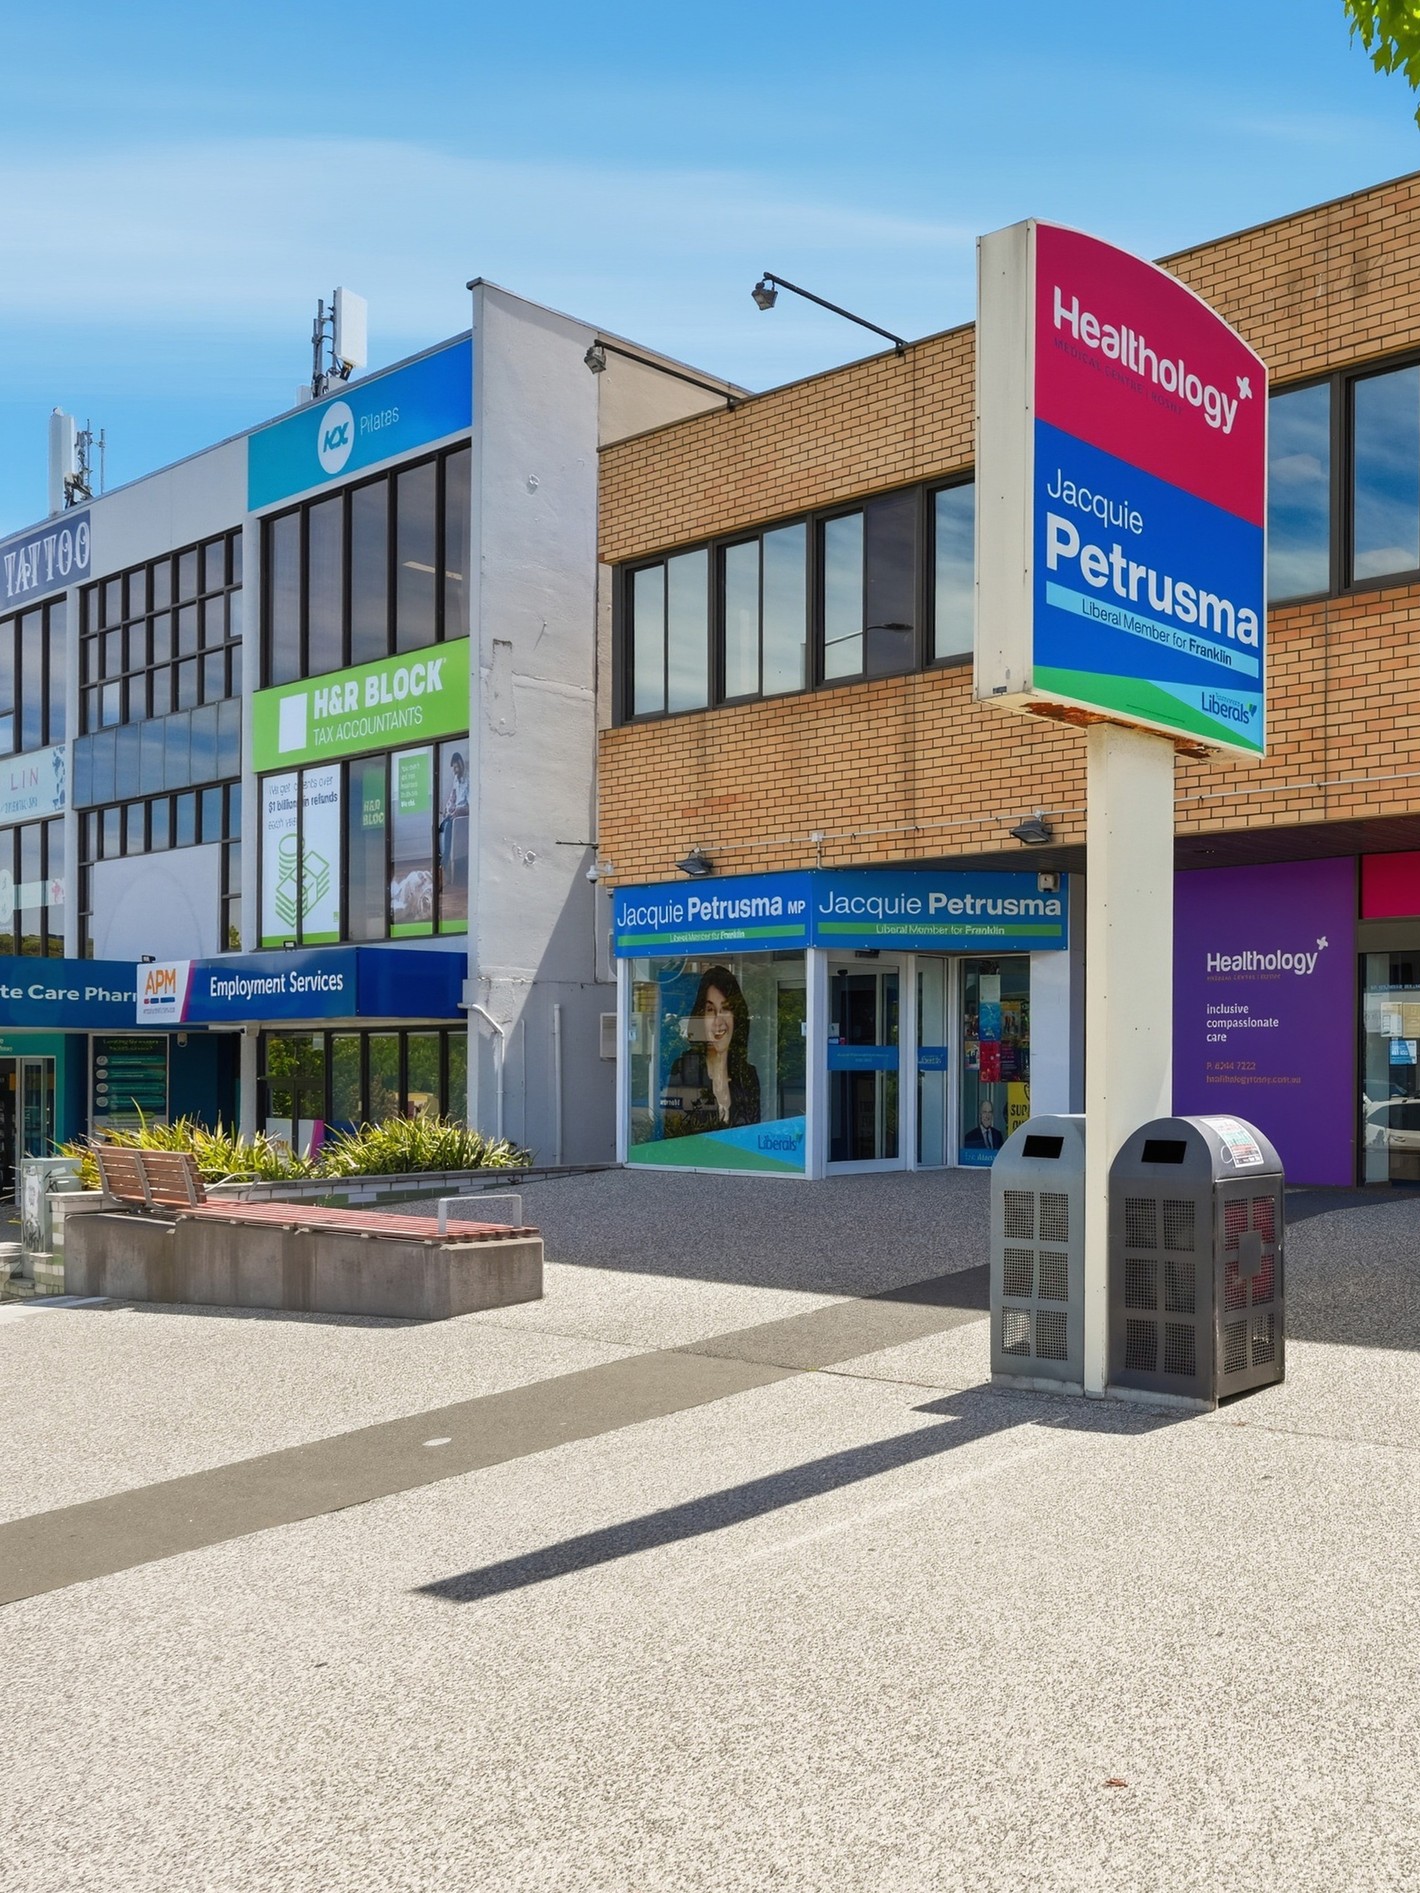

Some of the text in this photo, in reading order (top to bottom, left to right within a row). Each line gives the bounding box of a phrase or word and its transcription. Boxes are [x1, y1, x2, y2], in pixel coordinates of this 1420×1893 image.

[1054, 285, 1238, 434] Healthology
[360, 406, 400, 436] Pilates
[1047, 468, 1143, 535] Jacquie
[3, 521, 90, 598] TATTOO
[1046, 511, 1259, 648] Petrusma
[1082, 598, 1232, 666] Liberal Member for Franklin
[313, 657, 443, 720] H&R BLOCK
[1202, 691, 1250, 724] Liberals
[313, 705, 423, 746] TAX ACCOUNTANTS
[363, 812, 385, 826] BLOC
[617, 896, 806, 930] Jacquie Petrusma MP
[818, 890, 1062, 919] Jacquie Petrusma
[876, 924, 908, 934] Liberal
[965, 924, 1005, 935] Franklin
[1206, 949, 1318, 975] Healthology
[27, 984, 80, 1001] Care
[144, 968, 177, 995] APM
[210, 970, 344, 1001] Employment Services
[1206, 1003, 1249, 1014] inclusive
[1206, 1016, 1279, 1030] compassionate
[1206, 1033, 1227, 1042] care
[757, 1134, 797, 1152] Liberals
